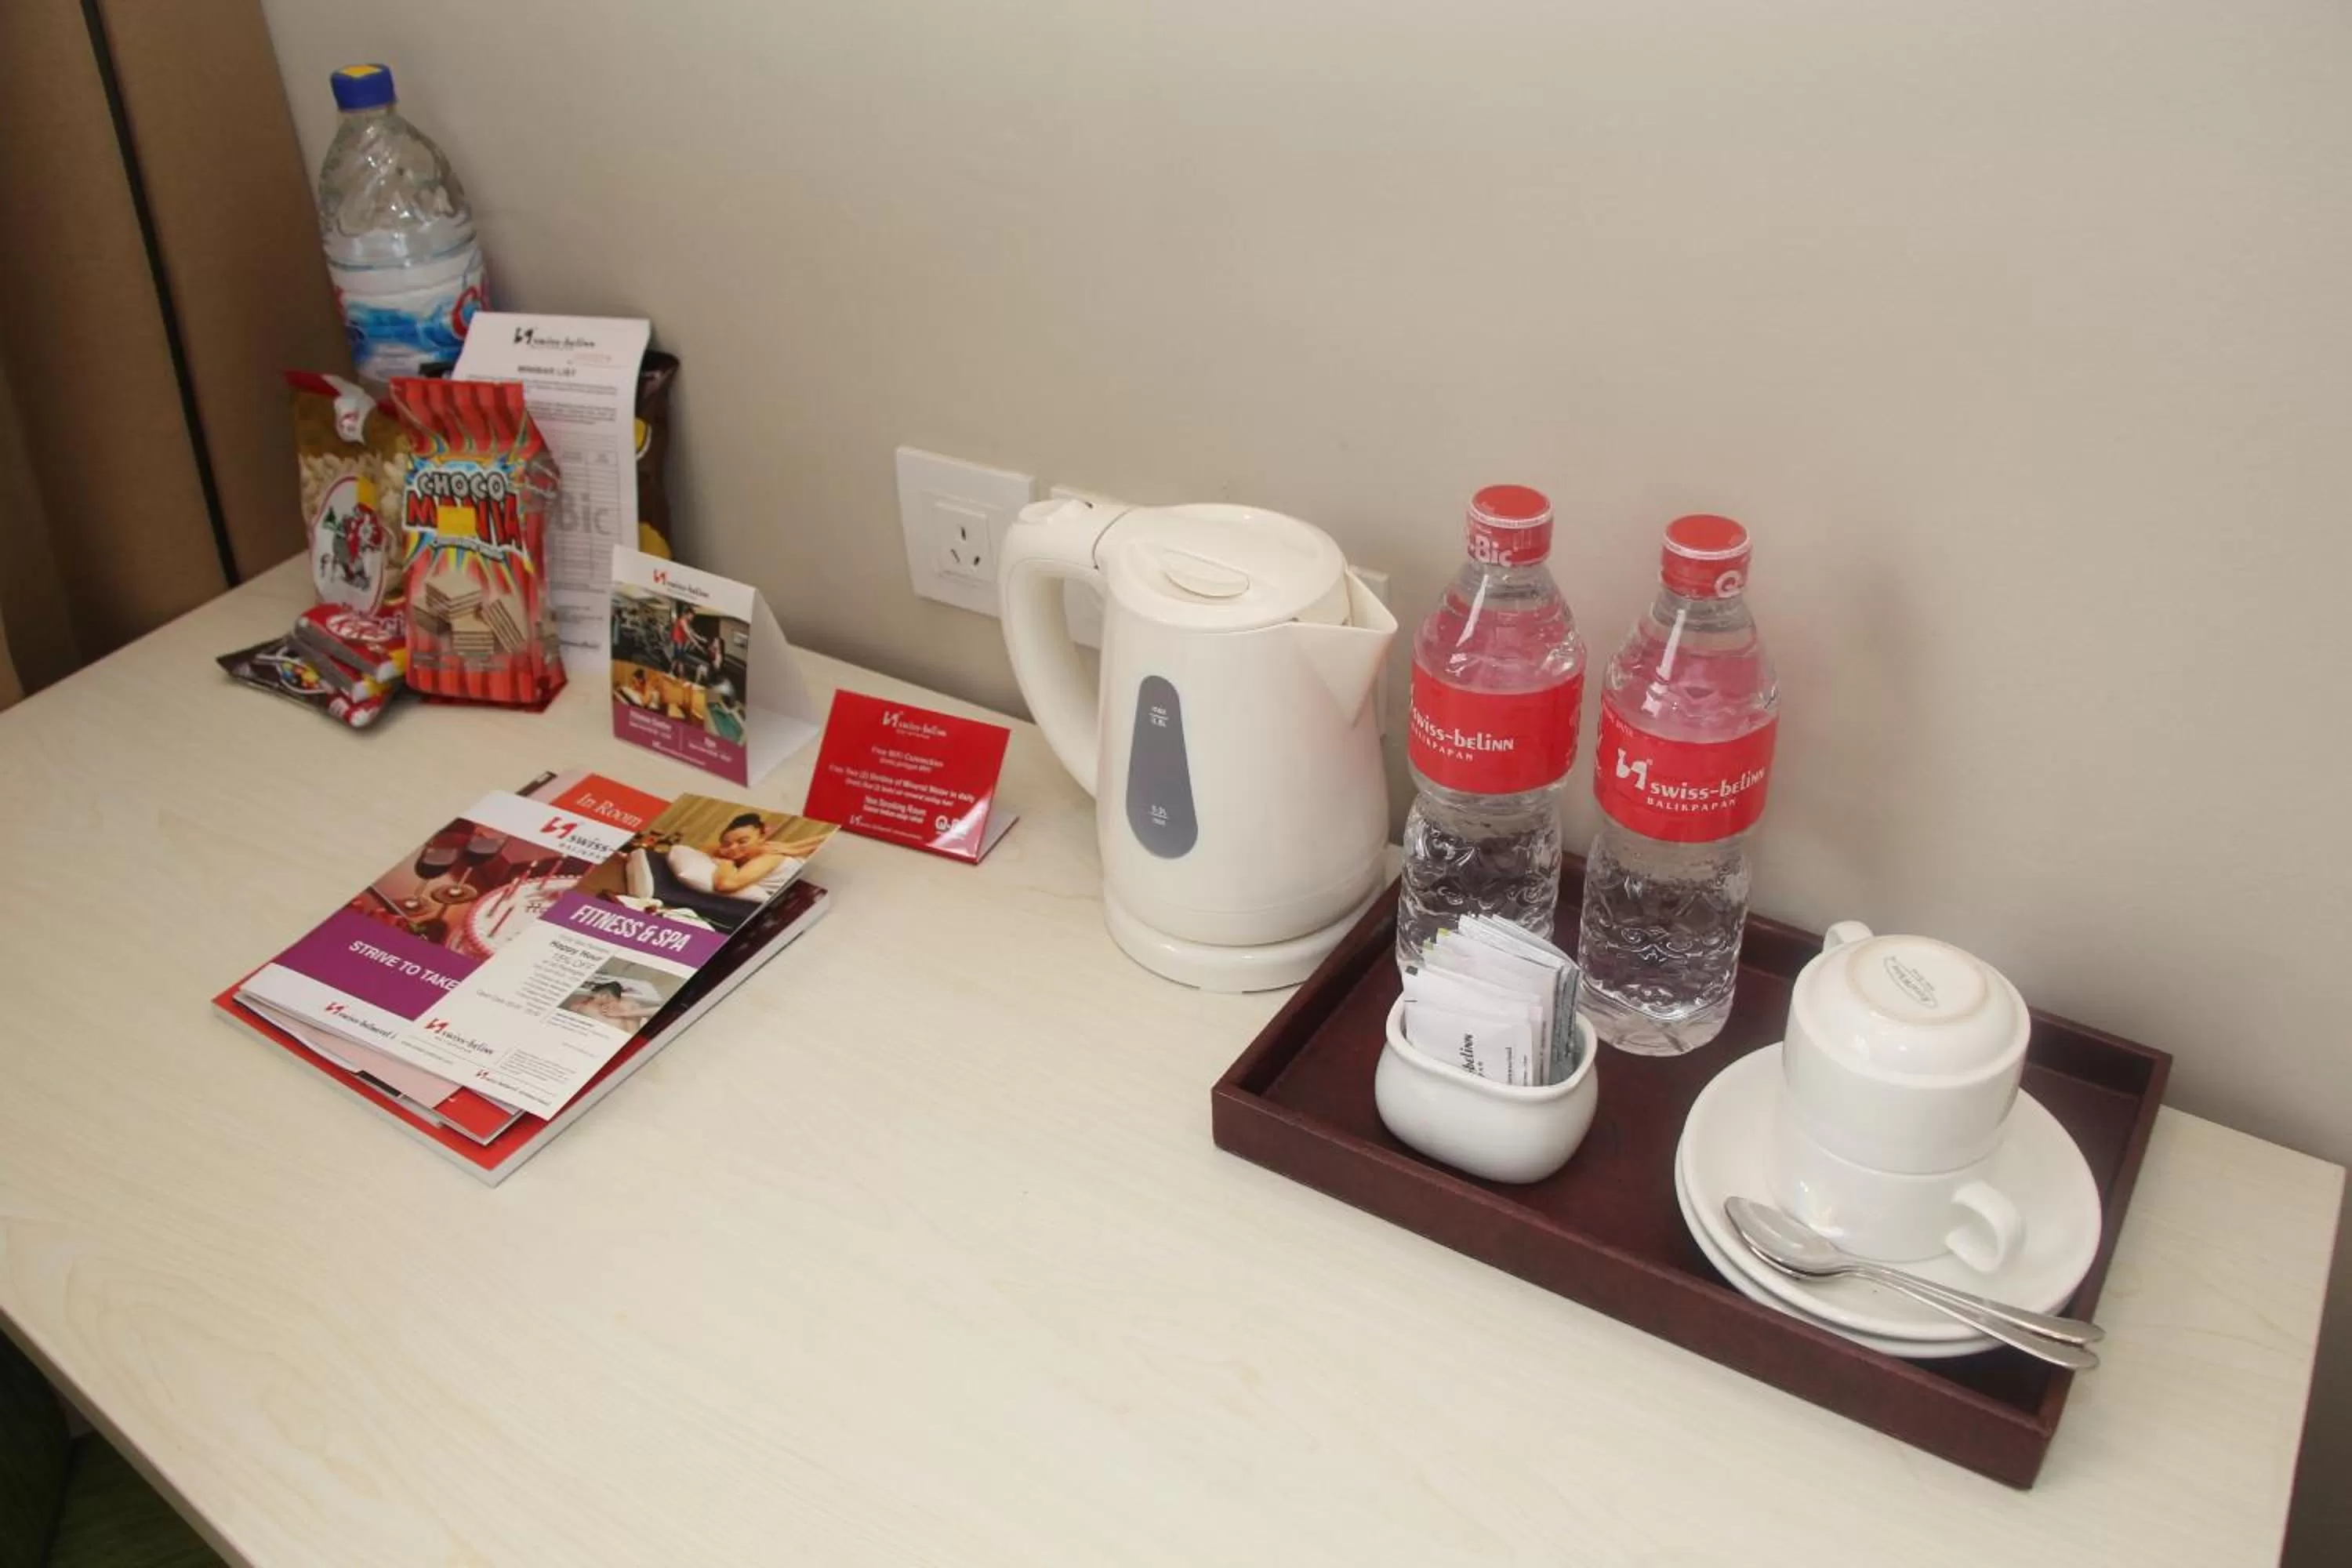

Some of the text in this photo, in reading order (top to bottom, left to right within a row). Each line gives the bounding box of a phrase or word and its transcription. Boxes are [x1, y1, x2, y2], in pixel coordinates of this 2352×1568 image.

[417, 471, 506, 503] CHOCO
[576, 793, 644, 828] In Room
[1647, 796, 1737, 813] BALIKPAPAN
[569, 904, 645, 938] FITNESS
[637, 925, 659, 943] &
[652, 928, 691, 953] SPA
[349, 940, 401, 968] STRIVE
[401, 959, 423, 976] TO
